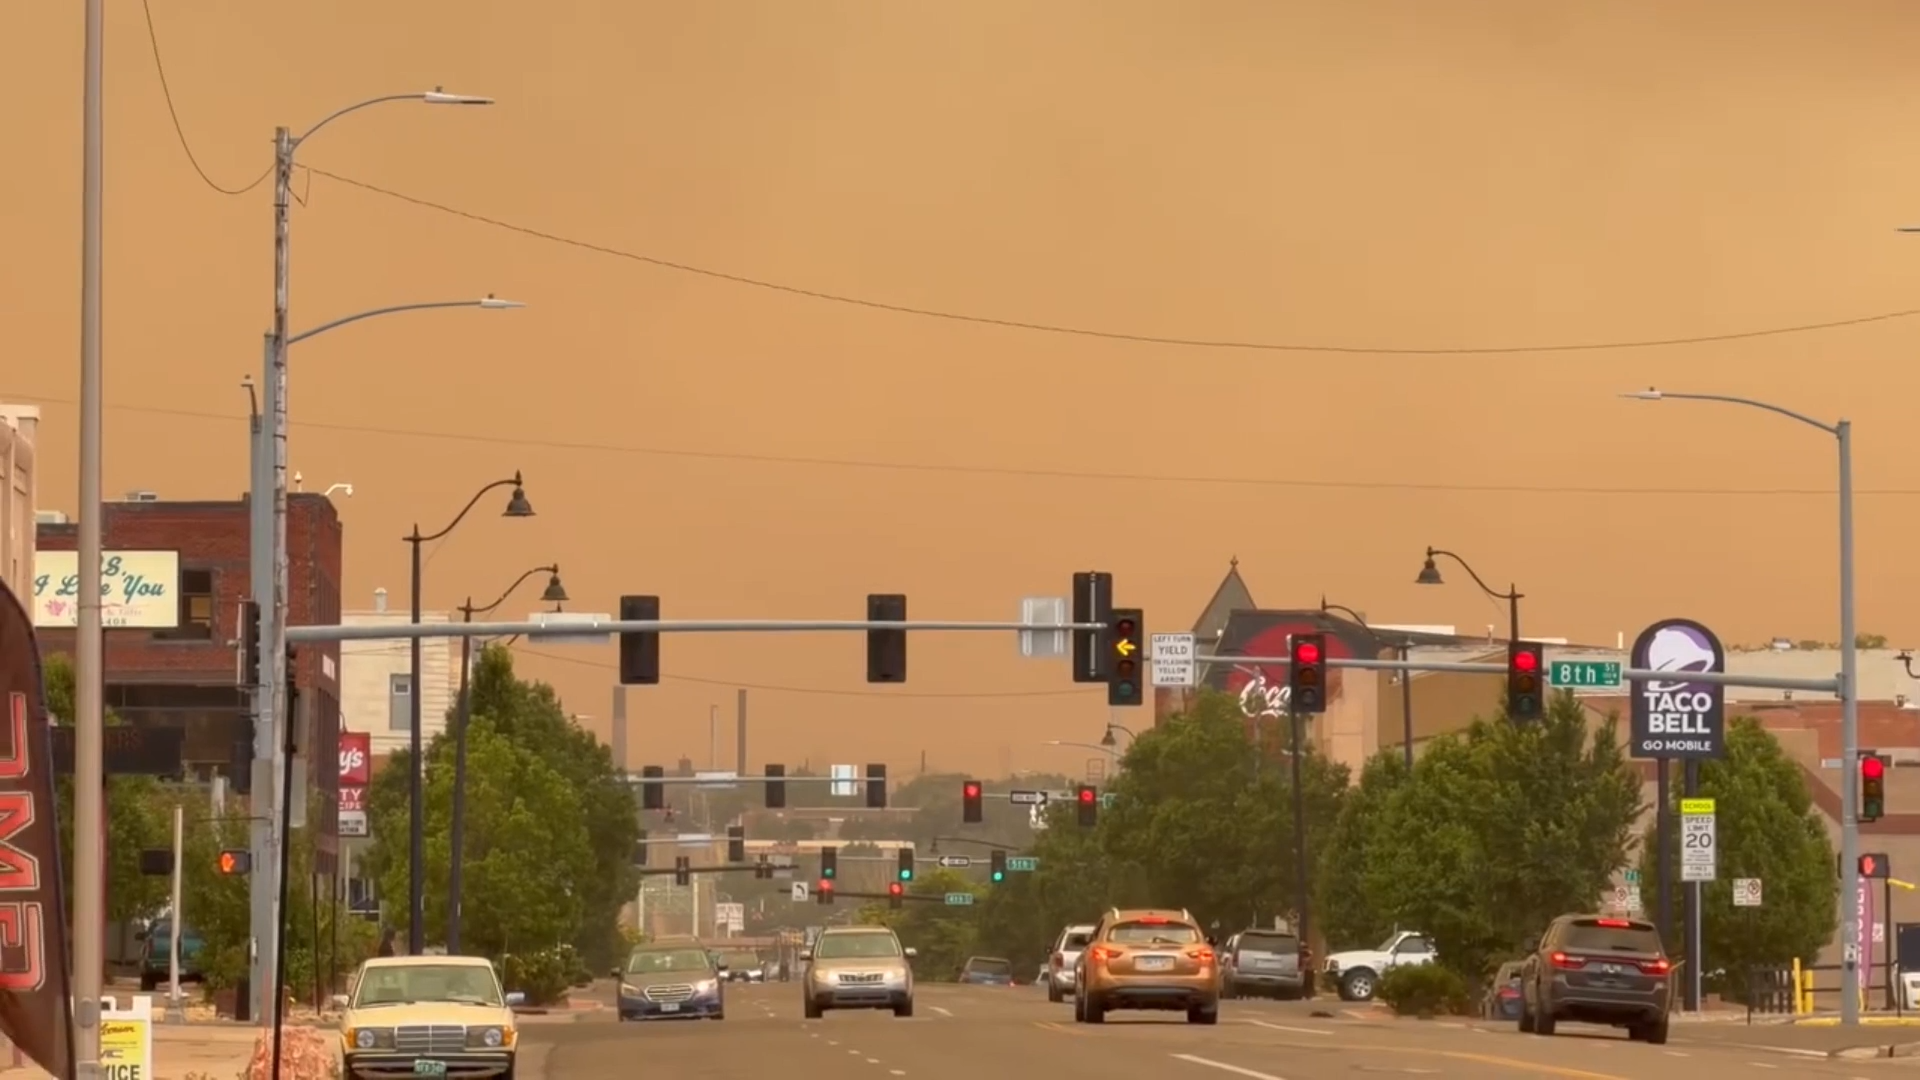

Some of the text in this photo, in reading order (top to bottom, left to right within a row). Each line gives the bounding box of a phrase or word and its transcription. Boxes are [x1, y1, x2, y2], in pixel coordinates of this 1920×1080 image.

[55, 574, 111, 596] Le
[123, 575, 164, 605] You
[1158, 646, 1188, 655] YIELD
[1560, 664, 1597, 684] 8th
[1643, 692, 1712, 712] TACO
[1649, 713, 1711, 733] BELL
[1643, 741, 1711, 751] GO MOBILE
[1685, 833, 1712, 849] 20
